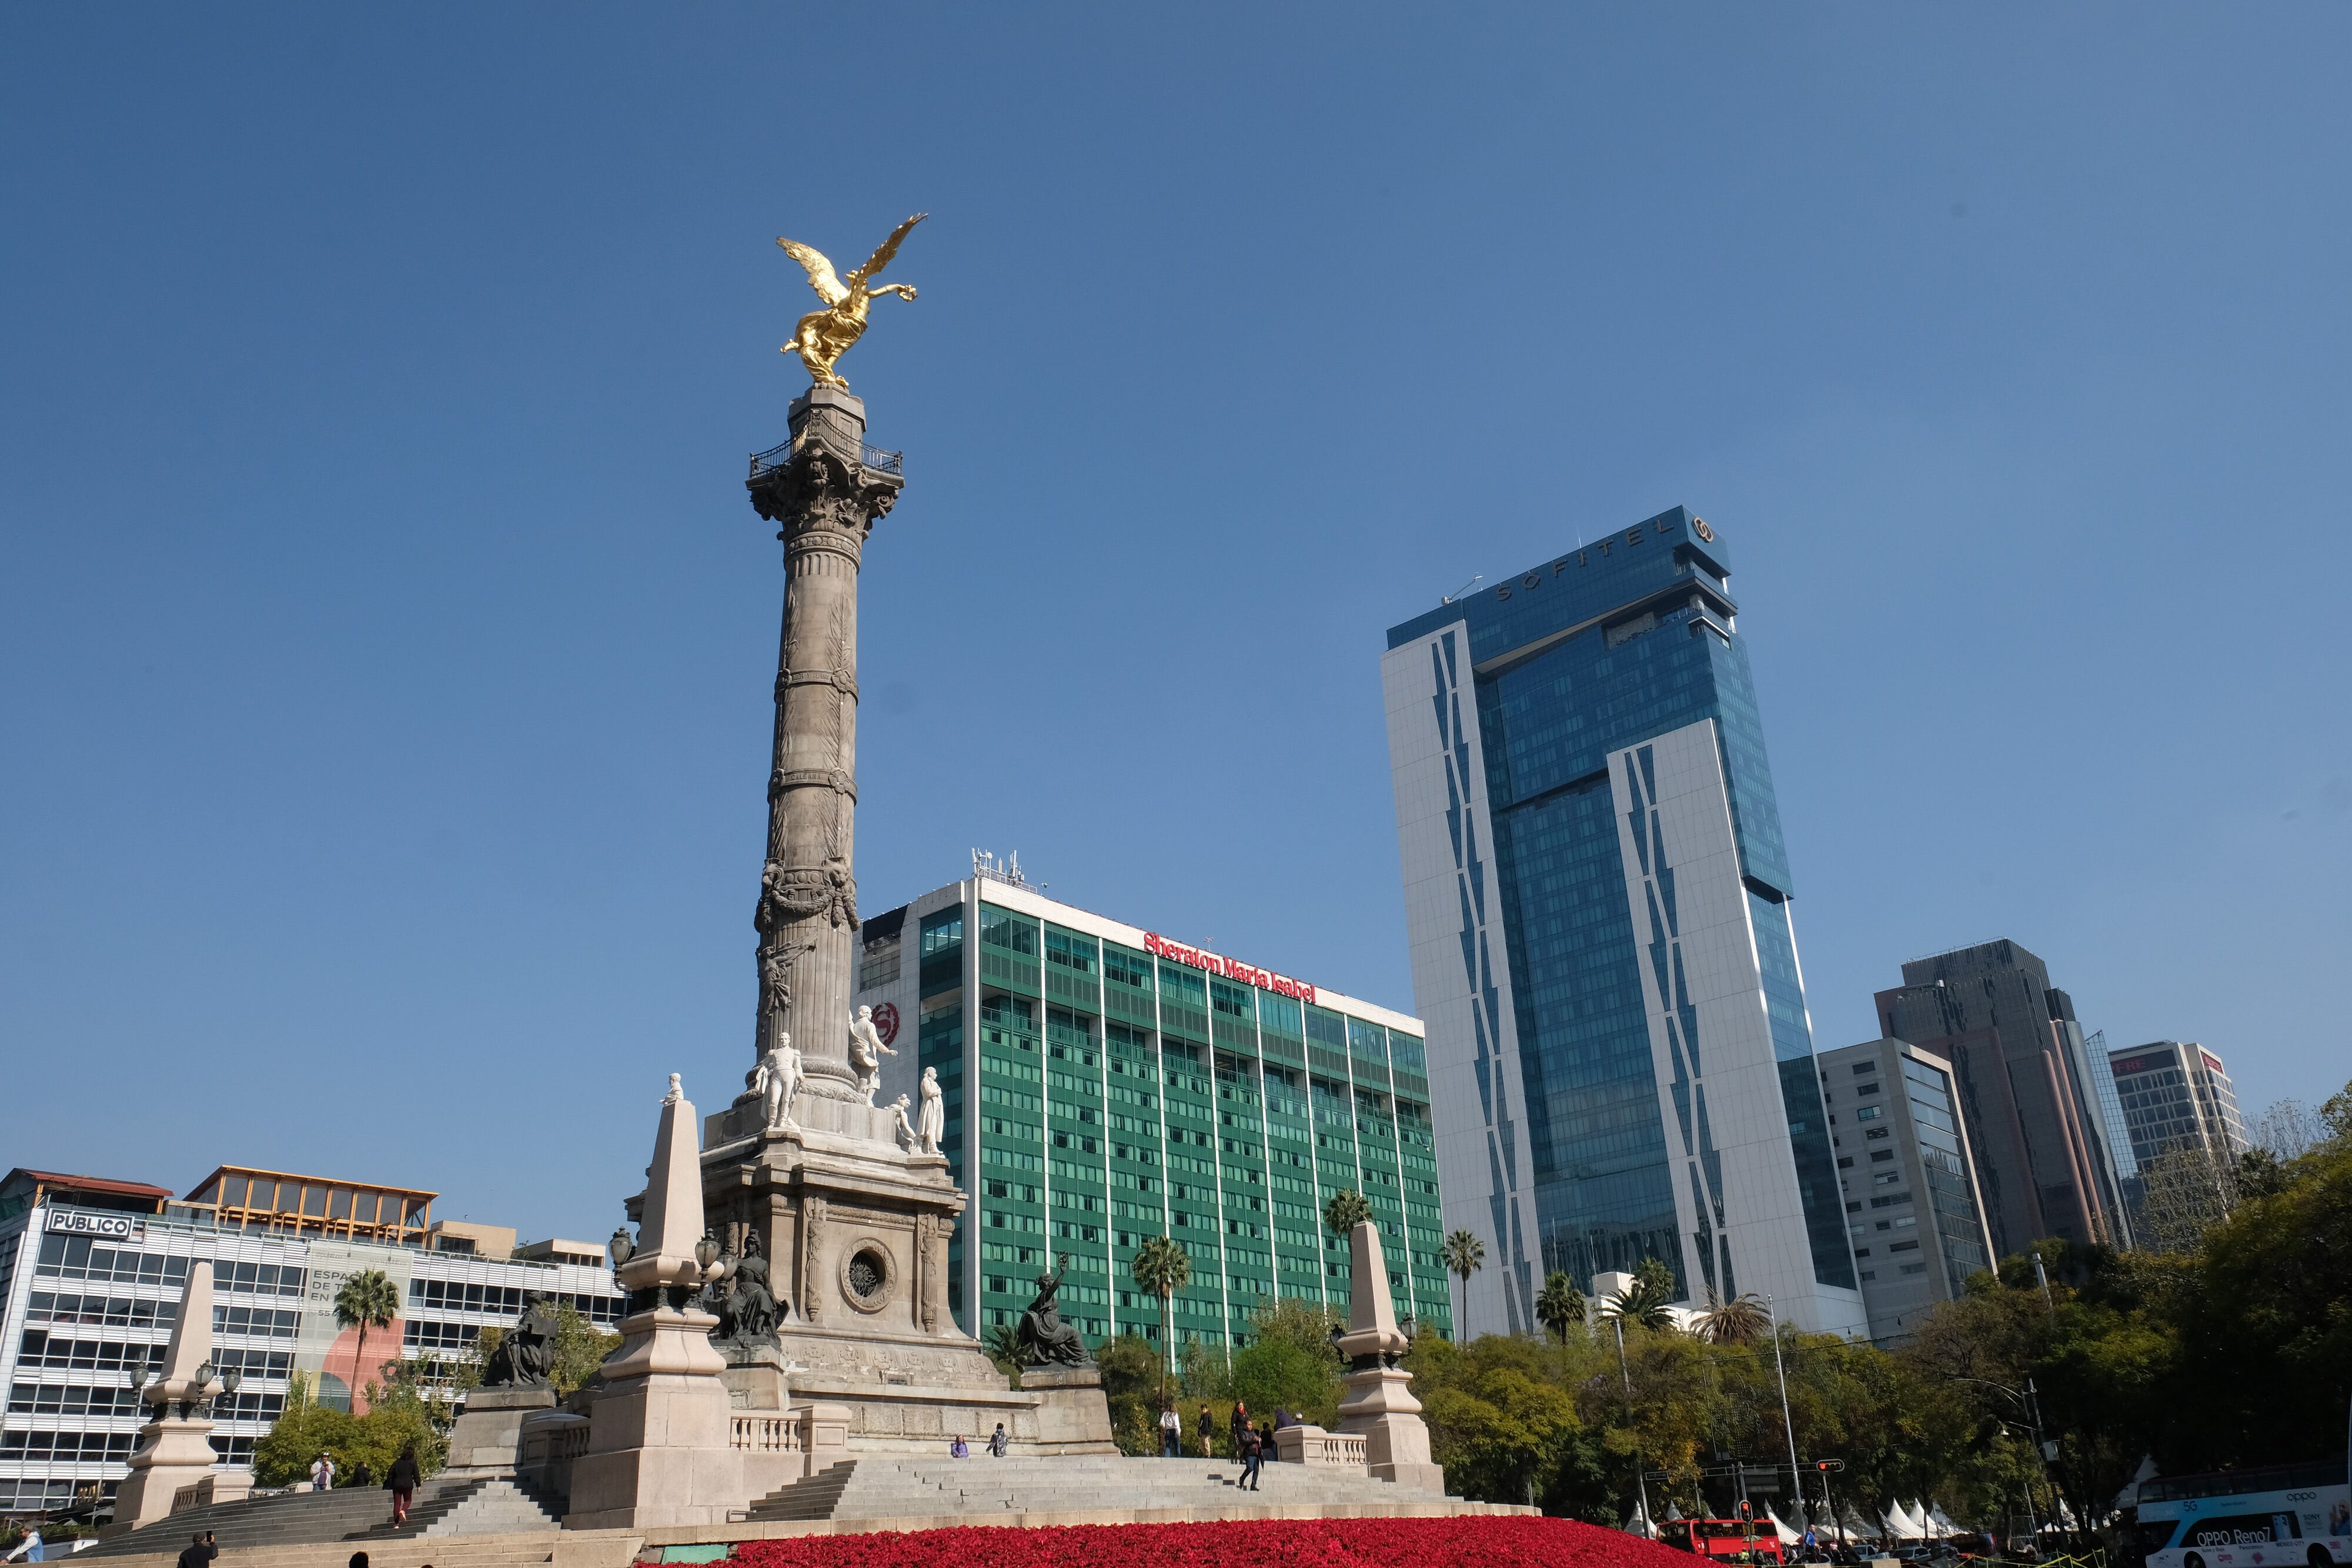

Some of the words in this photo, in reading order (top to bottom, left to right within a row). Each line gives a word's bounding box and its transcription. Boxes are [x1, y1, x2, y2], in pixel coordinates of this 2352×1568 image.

[1496, 519, 1675, 601] SOFITEL
[1144, 931, 1222, 974] Sheraton
[1223, 956, 1269, 988] Maria
[1271, 972, 1317, 1003] Isabel
[312, 1281, 330, 1290] DE
[310, 1292, 329, 1302] EN
[2287, 1492, 2317, 1502] oppo
[2183, 1500, 2197, 1512] 5G
[2197, 1530, 2231, 1547] OPPO
[2233, 1526, 2271, 1544] Reno7
